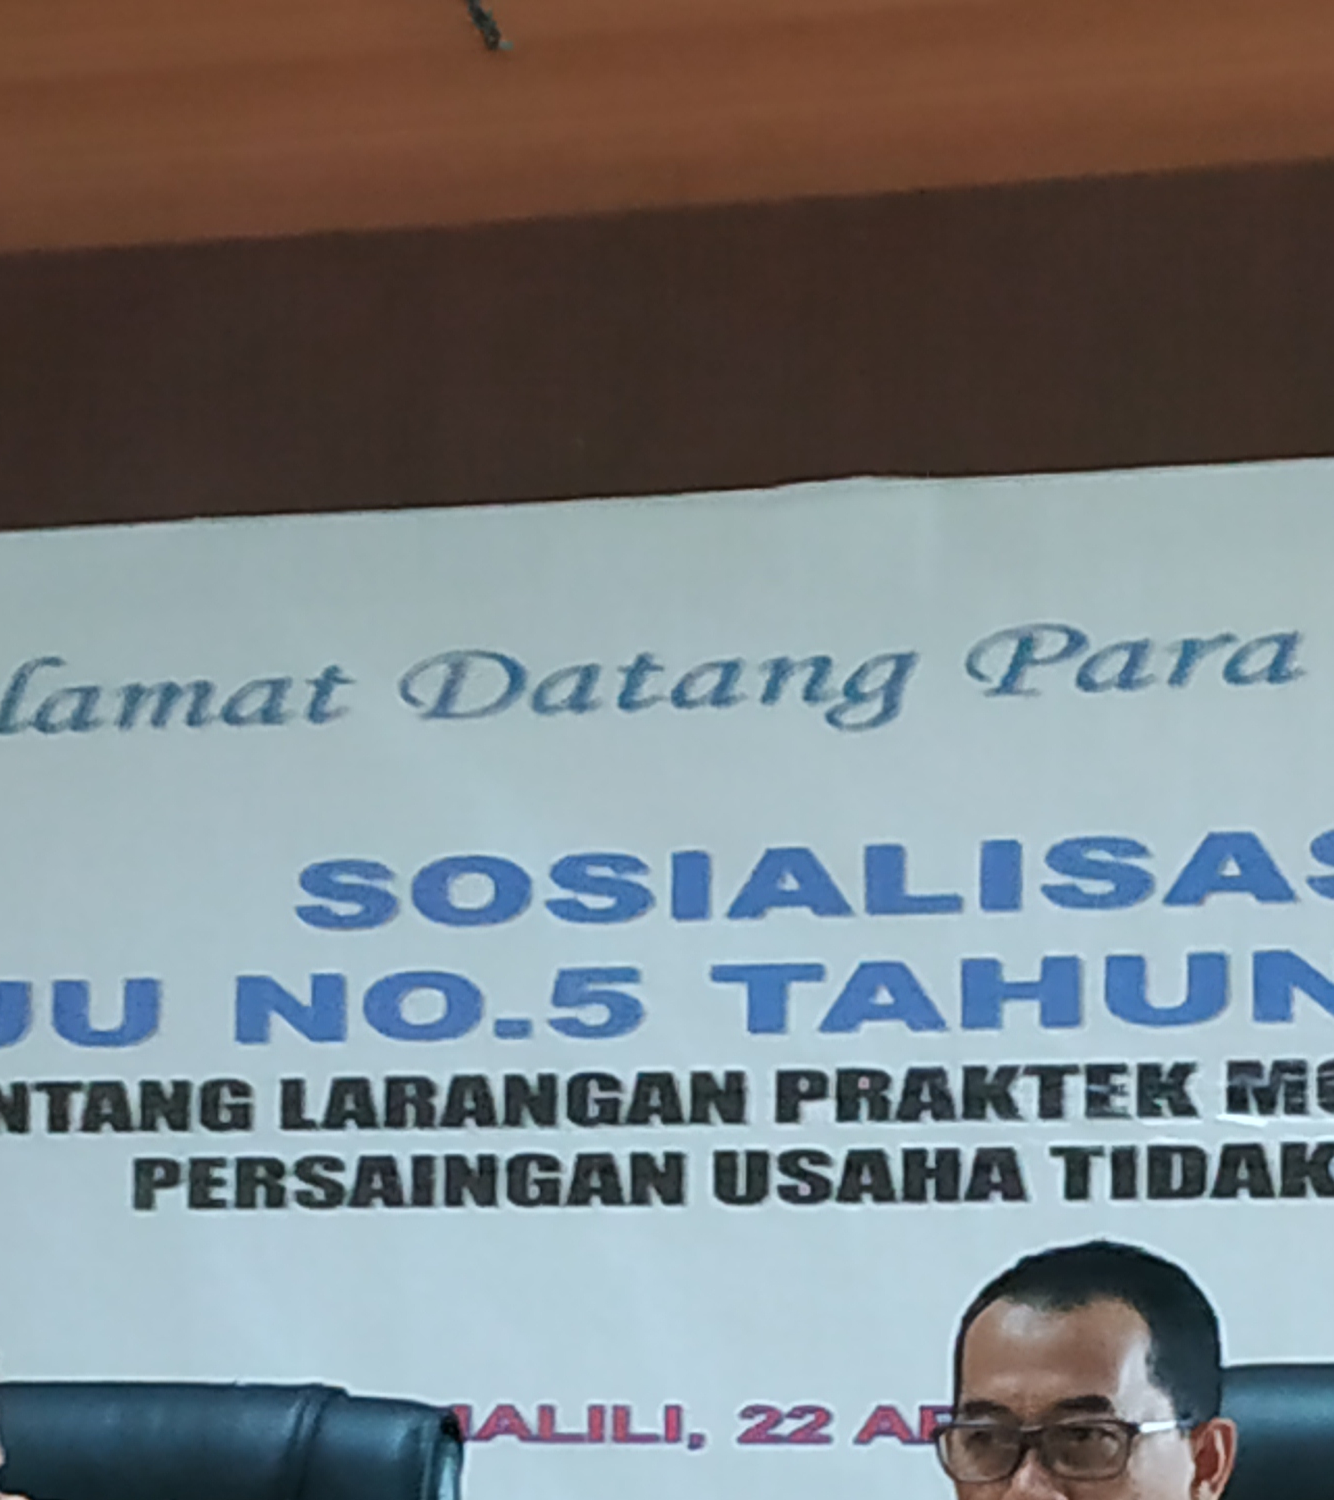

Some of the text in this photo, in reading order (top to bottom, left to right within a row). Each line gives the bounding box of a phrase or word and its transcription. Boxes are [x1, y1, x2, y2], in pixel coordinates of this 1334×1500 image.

[399, 648, 919, 732] Datang
[964, 620, 1307, 700] Para
[233, 966, 647, 1045] NO.5
[278, 1070, 749, 1132] LARANGAN
[773, 1060, 1199, 1126] PRAKTEK
[130, 1152, 687, 1211] PERSAINGAN
[713, 1145, 1031, 1206] USAHA
[735, 1404, 834, 1445] 22
[852, 1404, 955, 1445] AP
